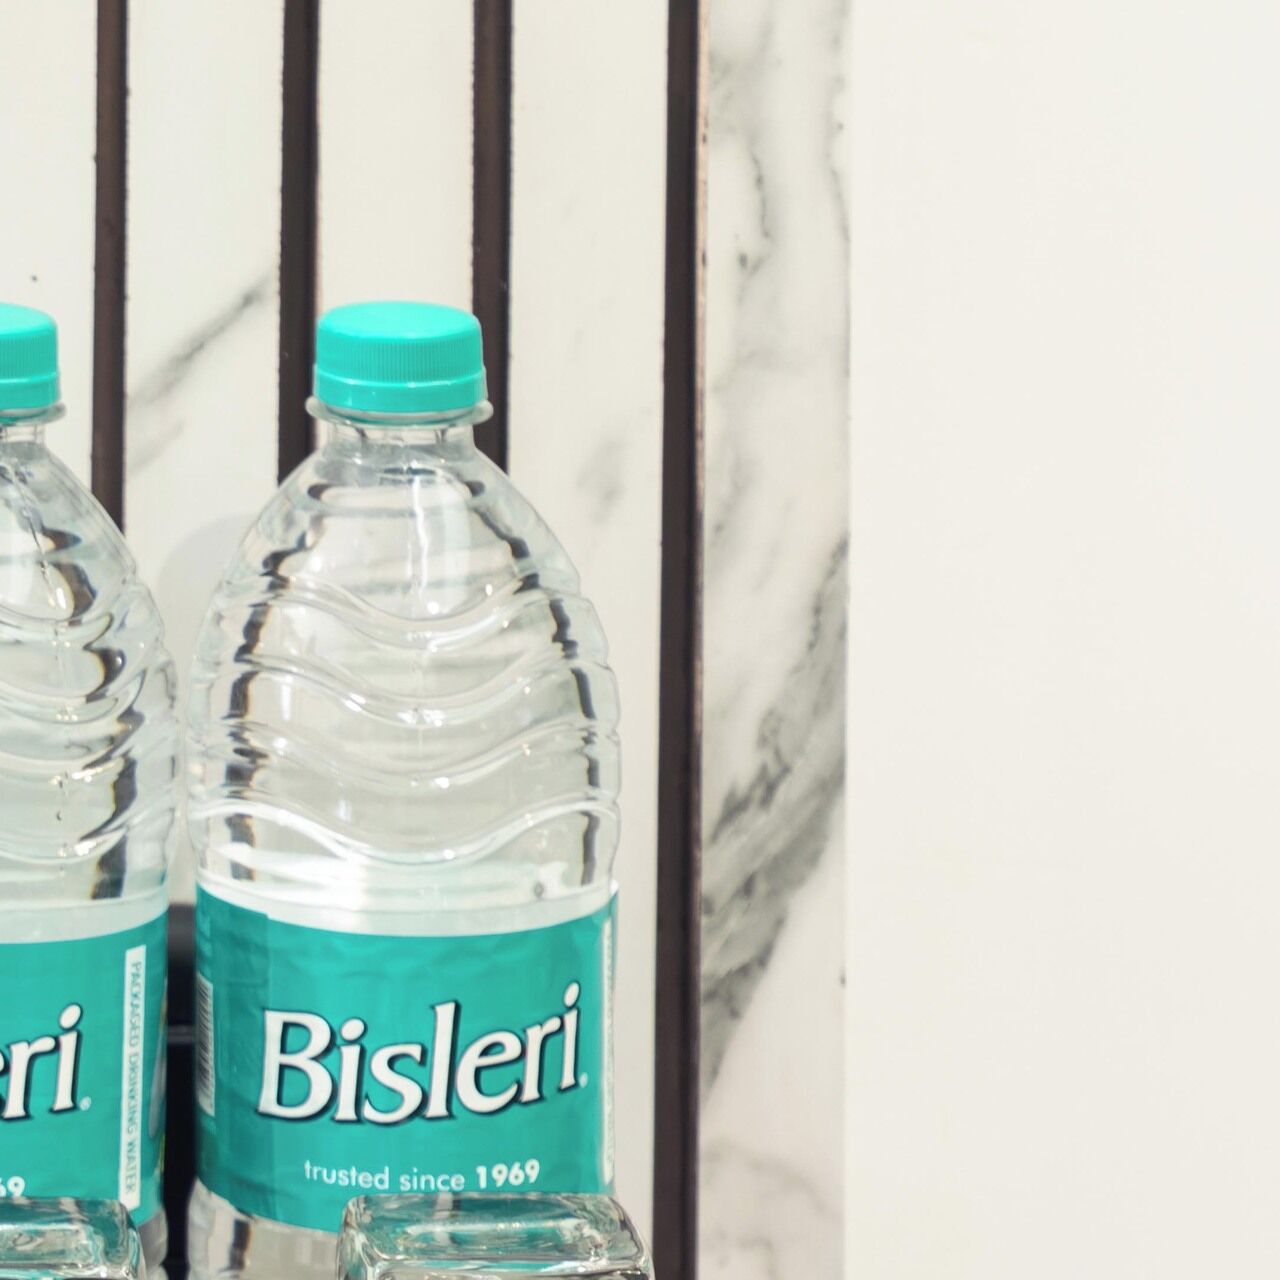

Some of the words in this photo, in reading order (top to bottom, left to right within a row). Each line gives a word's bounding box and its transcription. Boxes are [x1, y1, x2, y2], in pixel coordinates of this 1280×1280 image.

[125, 959, 142, 1053] PACKAGED
[122, 1053, 140, 1138] DRINKING
[256, 979, 581, 1125] Bisleri
[304, 1159, 390, 1190] trusted
[399, 1166, 466, 1192] since
[475, 1158, 540, 1189] 1969
